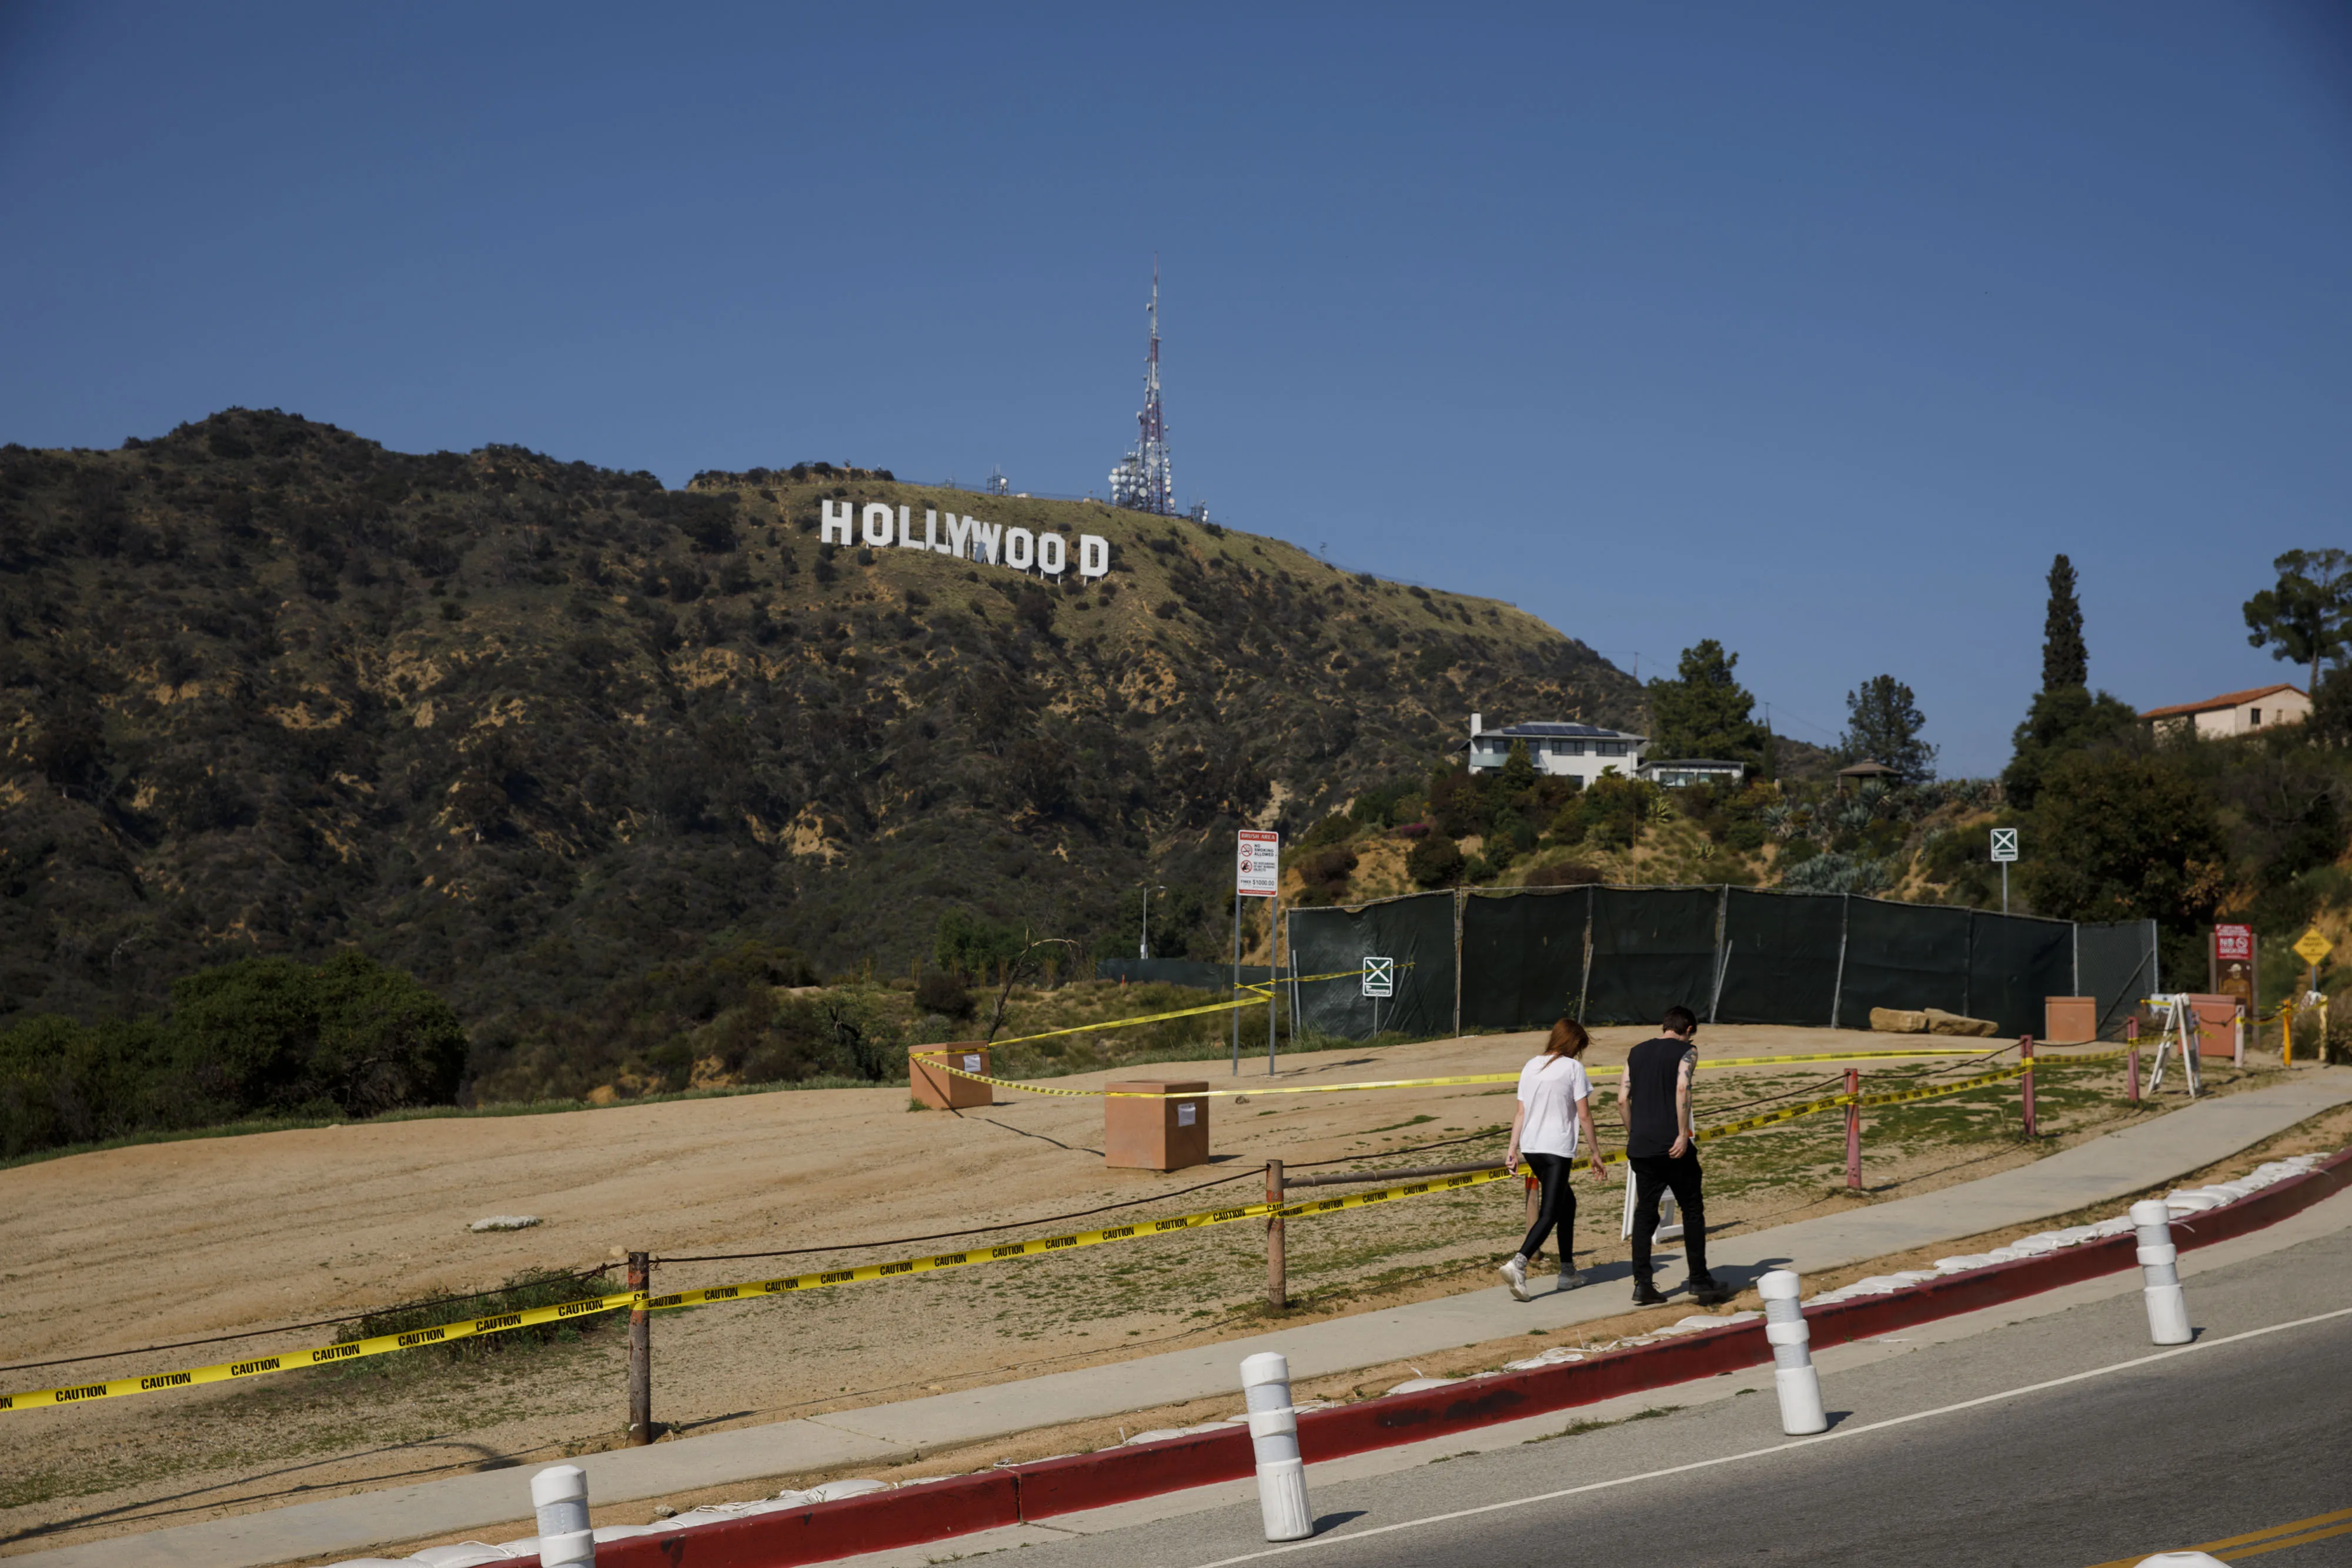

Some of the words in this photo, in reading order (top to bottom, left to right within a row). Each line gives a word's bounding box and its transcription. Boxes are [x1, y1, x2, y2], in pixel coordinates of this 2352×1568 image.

[821, 499, 1109, 577] HOLLYWOOD
[1318, 1199, 1344, 1211] CAUTION
[1362, 1191, 1388, 1204] CAUTION
[1404, 1183, 1428, 1195] CAUTION
[1448, 1175, 1472, 1188] CAUTION
[1489, 1168, 1510, 1179] CAUTIO
[648, 1293, 682, 1308] CAUTION
[704, 1287, 739, 1300] CAUTION
[765, 1279, 799, 1292] CAUTION
[820, 1271, 854, 1284] CAUTION
[880, 1262, 913, 1276] CAUTION
[934, 1253, 967, 1267] CAUTION
[992, 1244, 1025, 1258] CAUTION
[1045, 1235, 1077, 1249] CAUTION
[1102, 1226, 1134, 1240] CAUTION
[1155, 1217, 1188, 1231] CAUTION
[1213, 1208, 1246, 1222] CAUTION
[56, 1385, 107, 1402] CAUTION
[141, 1372, 192, 1390] CAUTION
[231, 1358, 280, 1376] CAUTION
[312, 1344, 360, 1361] CAUTION
[398, 1328, 445, 1346] CAUTION
[476, 1315, 522, 1332] CAUTION
[558, 1299, 603, 1317] CAUTION
